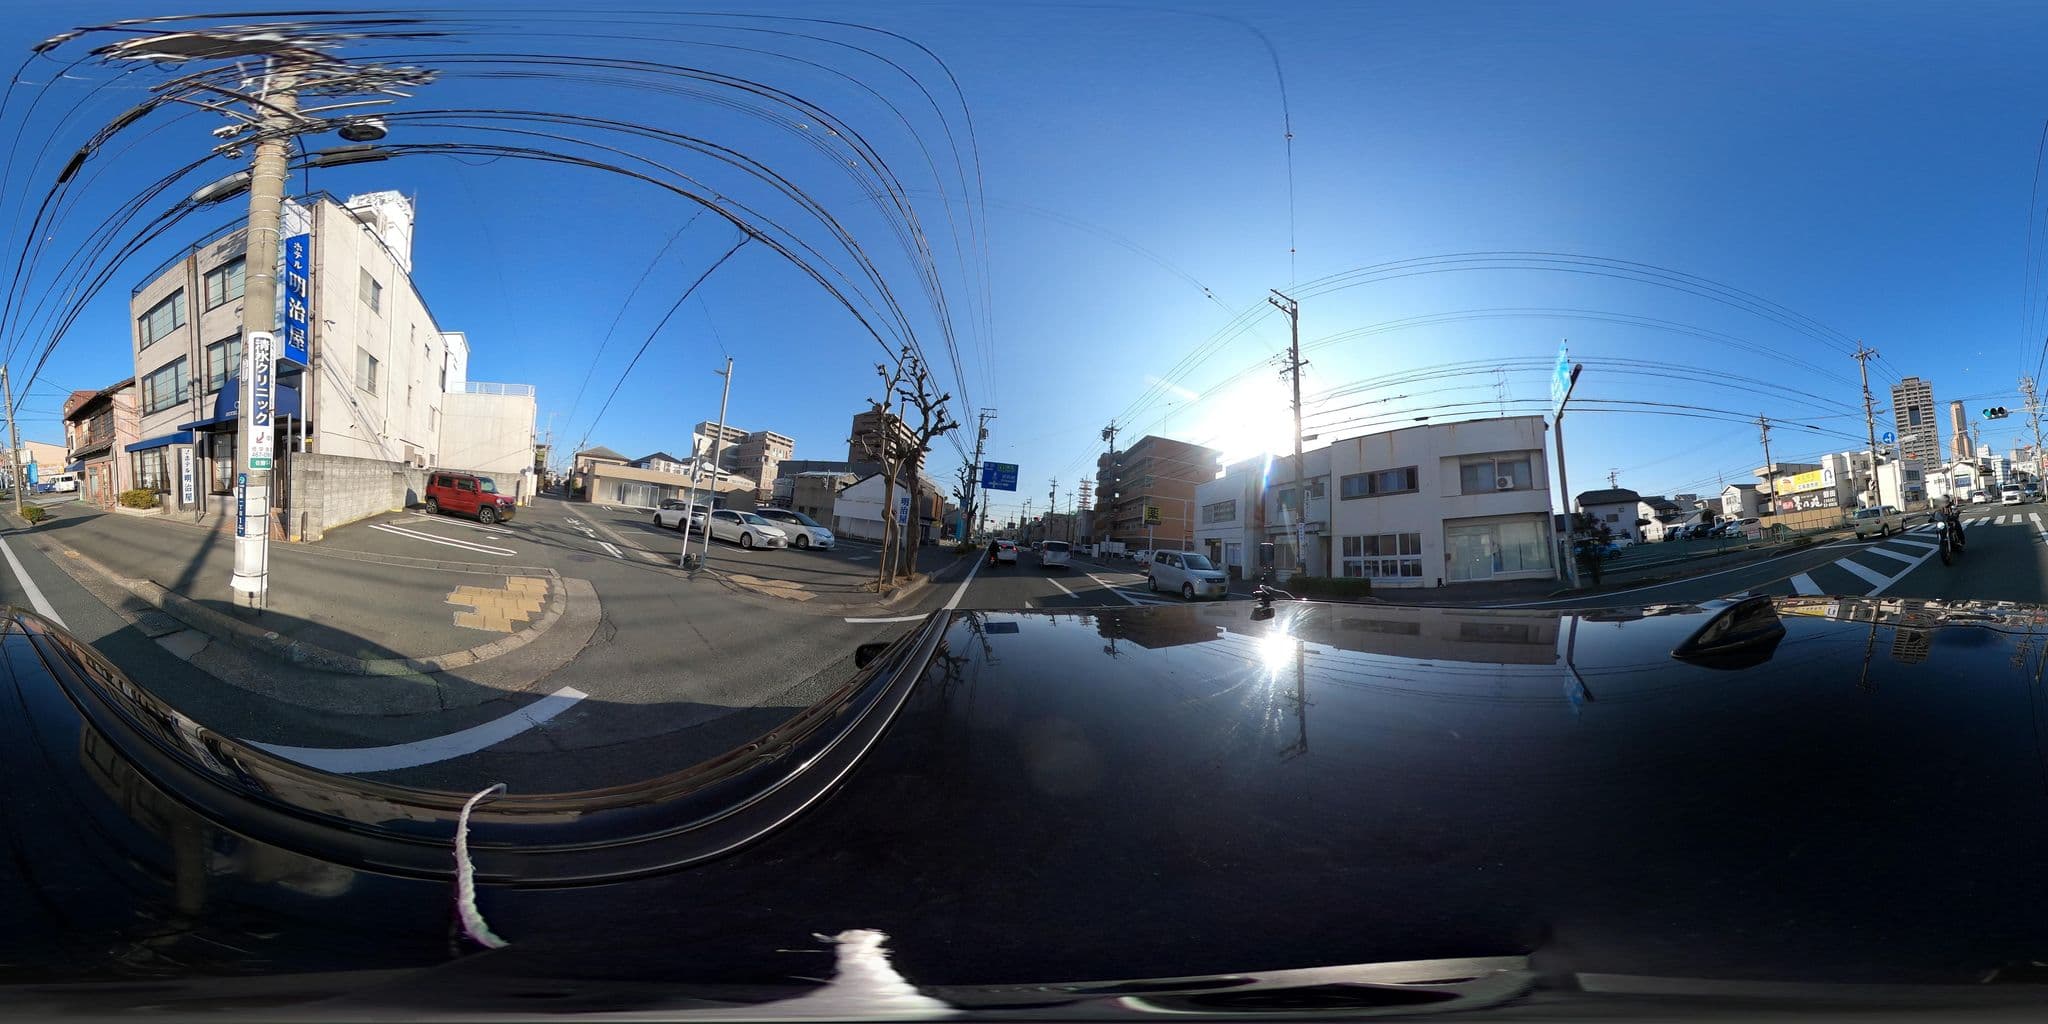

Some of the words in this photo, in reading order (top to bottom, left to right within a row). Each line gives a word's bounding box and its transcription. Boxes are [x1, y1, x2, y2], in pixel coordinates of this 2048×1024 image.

[254, 338, 270, 425] 清水クリニック
